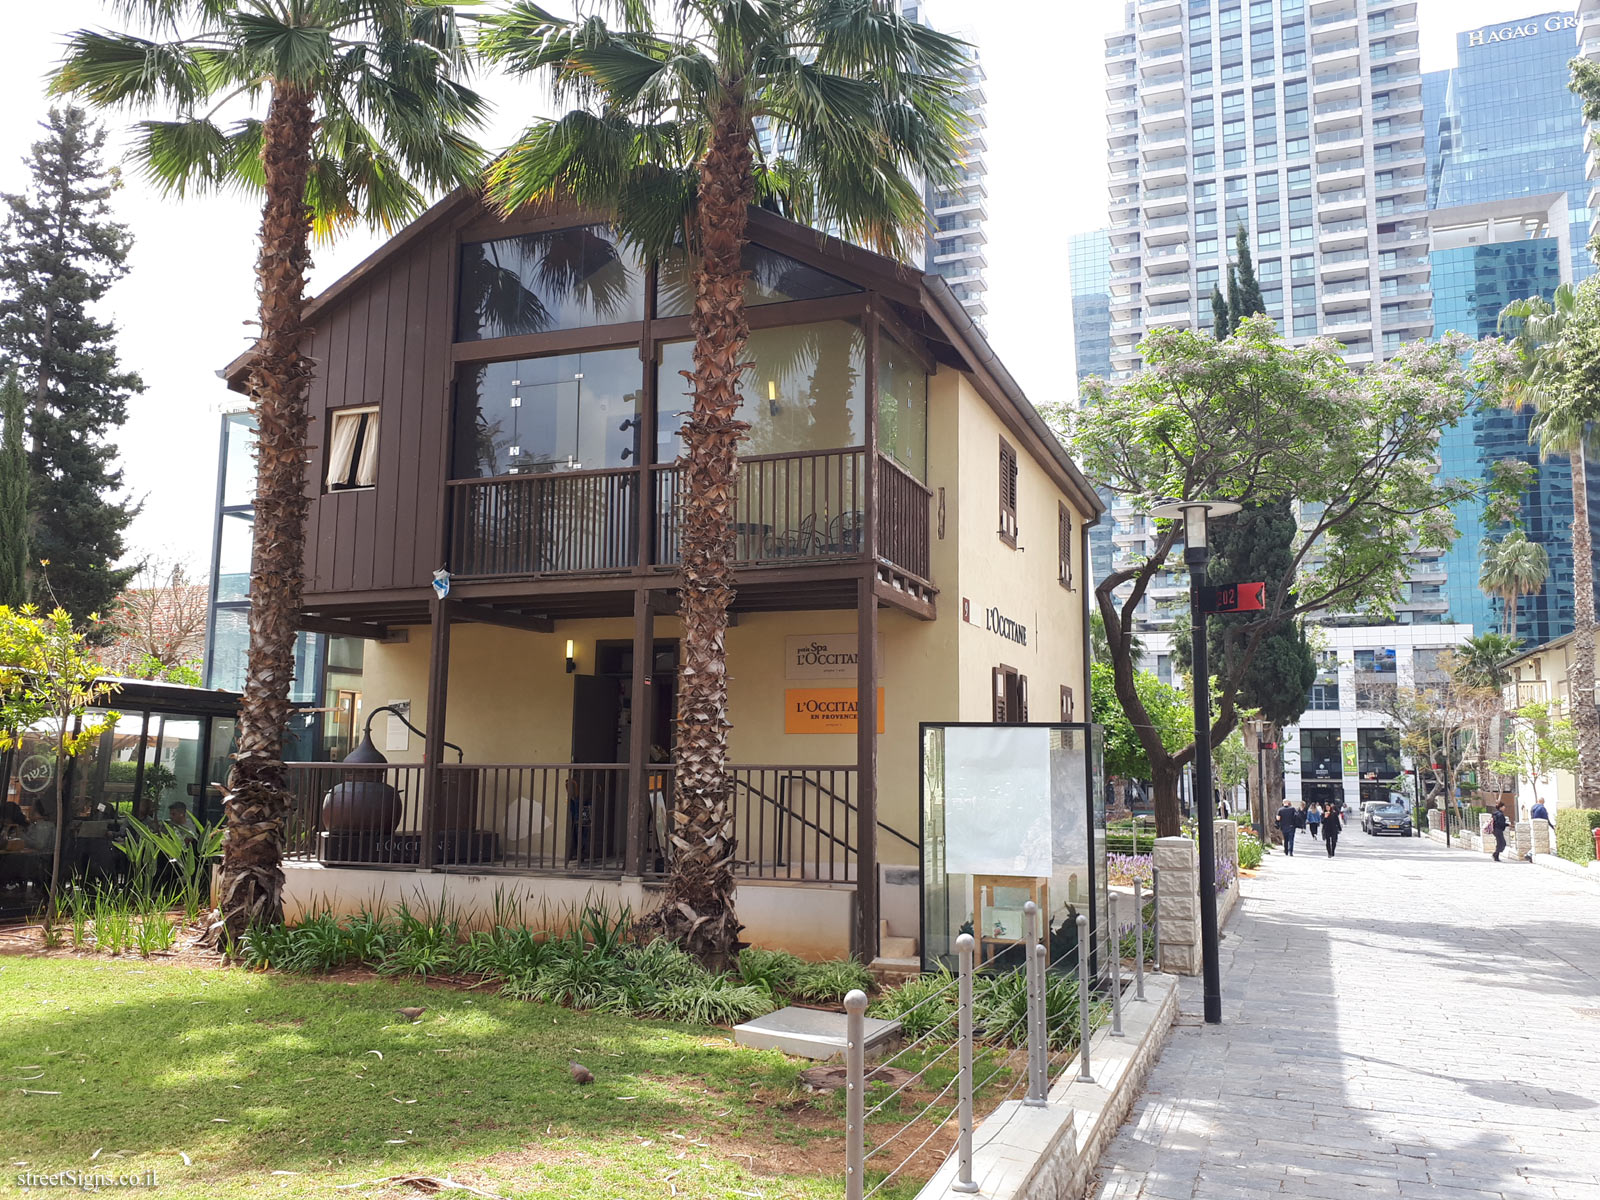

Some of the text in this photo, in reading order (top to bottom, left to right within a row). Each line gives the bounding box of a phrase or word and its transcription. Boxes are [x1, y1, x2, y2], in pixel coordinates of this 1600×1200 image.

[1468, 23, 1538, 47] HAGAG
[986, 607, 1027, 647] L'OCCITANE
[811, 642, 828, 655] Spa
[23, 764, 48, 782] כשר
